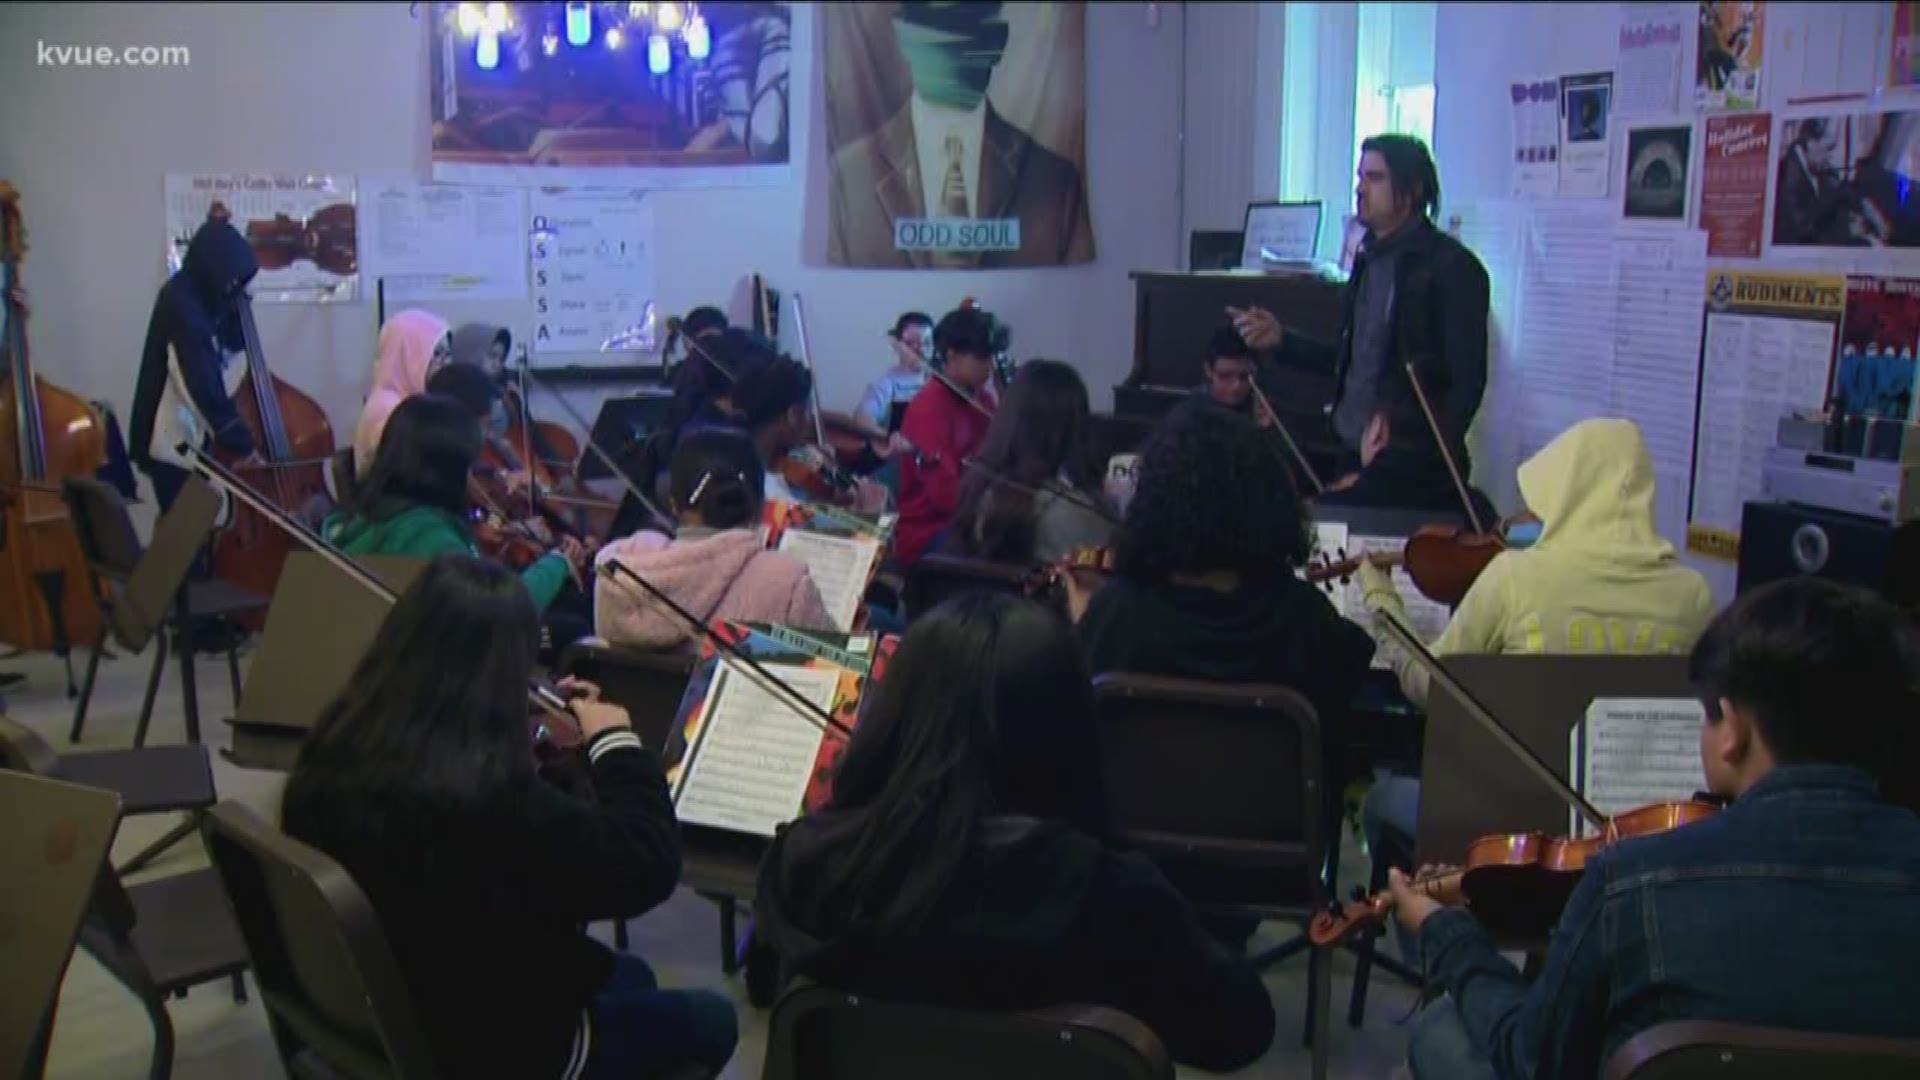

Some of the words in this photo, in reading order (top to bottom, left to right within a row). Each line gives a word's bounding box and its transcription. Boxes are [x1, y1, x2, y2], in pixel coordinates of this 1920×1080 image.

[899, 222, 951, 248] ODD
[958, 222, 1017, 248] SOUL
[536, 242, 546, 258] S
[536, 270, 547, 286] S
[1735, 280, 1841, 307] RUDIMENTS
[537, 296, 548, 312] S
[538, 324, 550, 341] A
